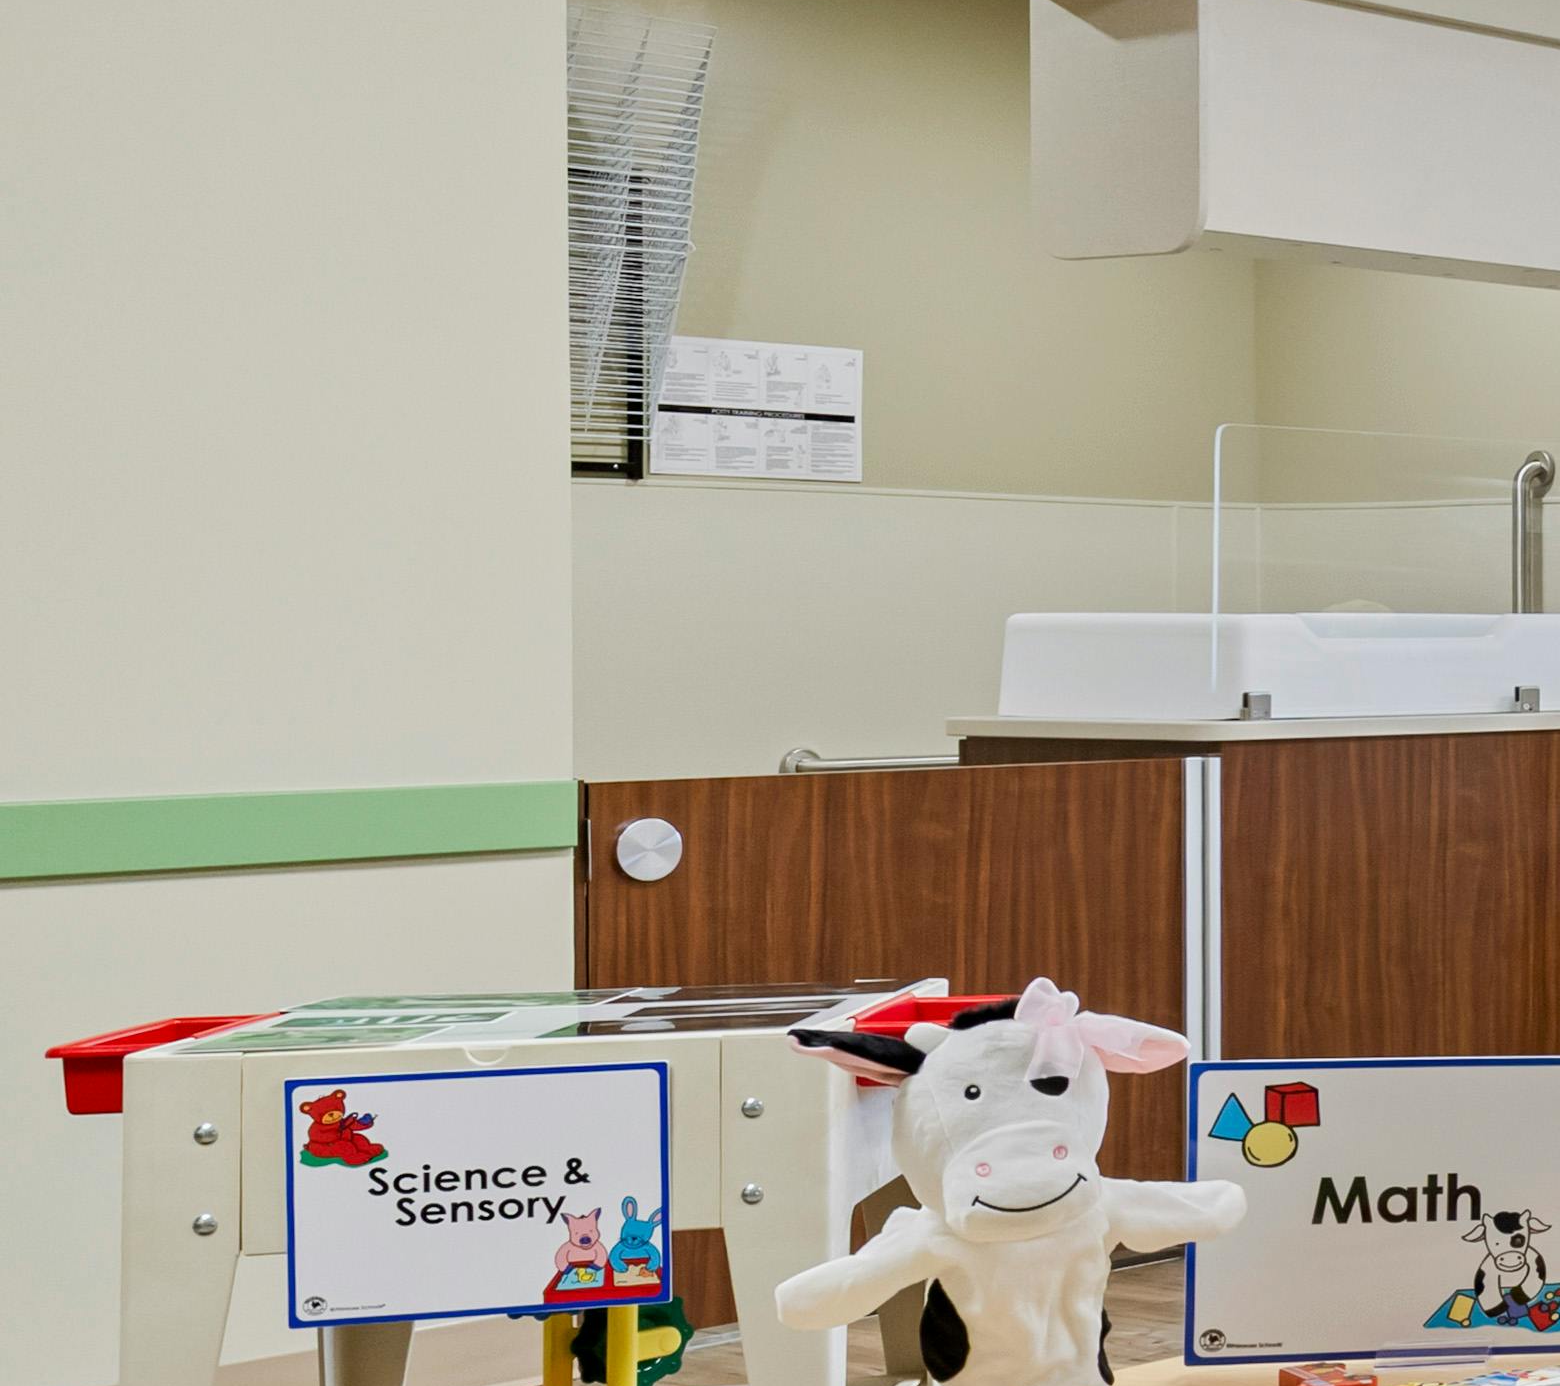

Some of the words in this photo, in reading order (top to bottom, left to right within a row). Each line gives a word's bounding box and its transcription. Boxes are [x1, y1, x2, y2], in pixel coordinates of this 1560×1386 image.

[368, 1164, 547, 1196] Science
[563, 1157, 591, 1185] &
[395, 1196, 566, 1226] Sensory
[1311, 1173, 1481, 1224] Math
